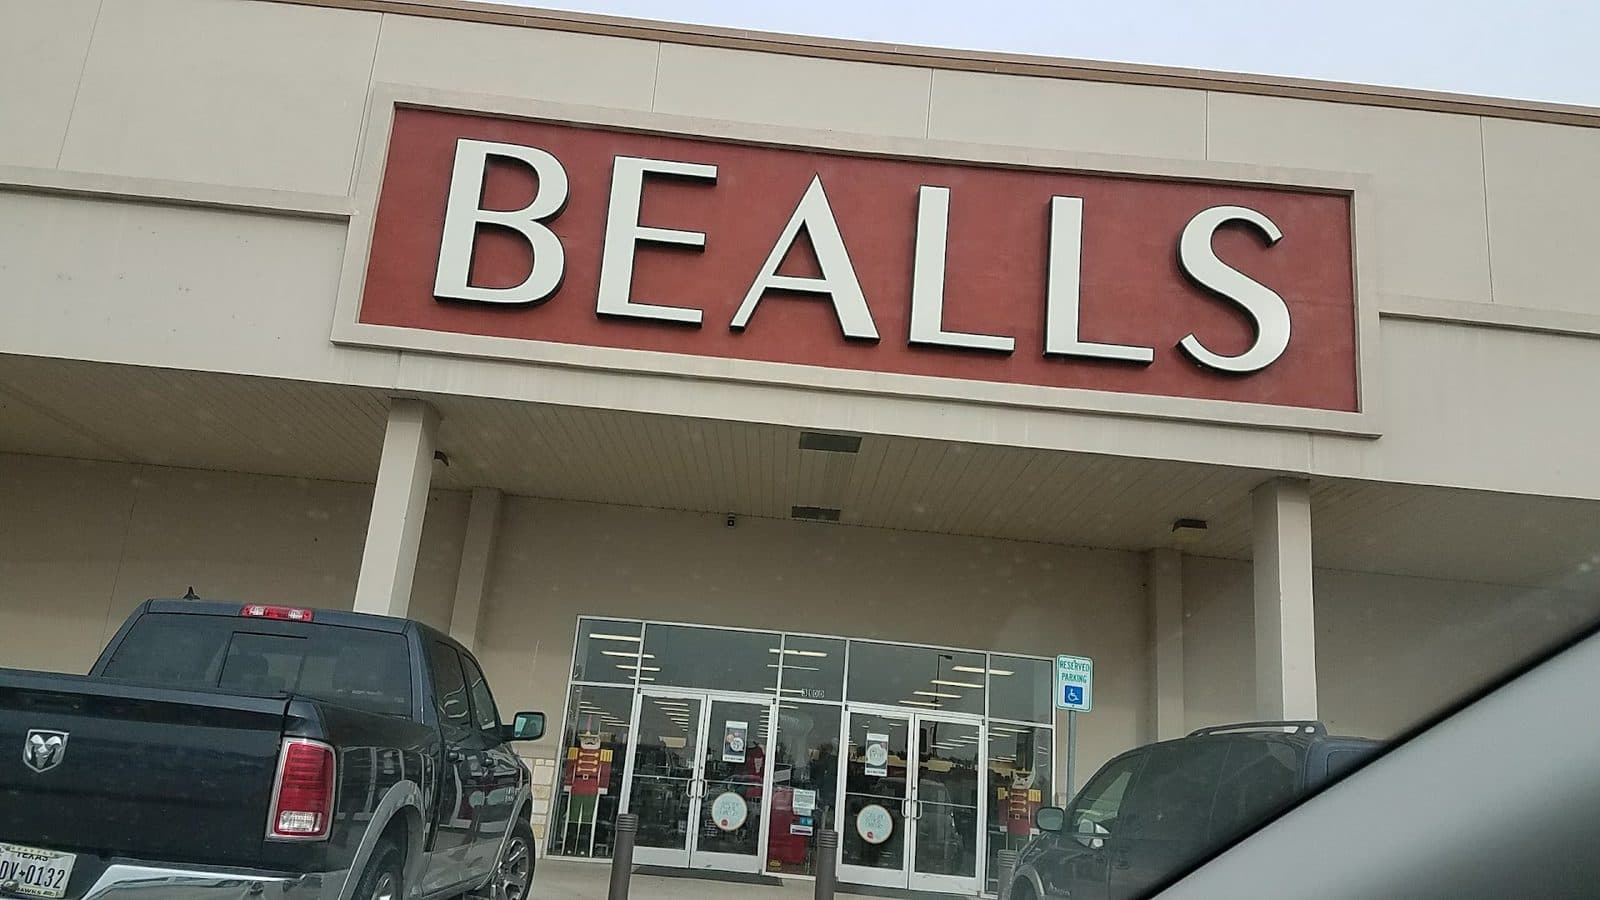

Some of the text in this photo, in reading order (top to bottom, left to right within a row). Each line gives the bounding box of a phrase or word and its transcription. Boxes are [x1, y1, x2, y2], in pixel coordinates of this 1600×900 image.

[433, 137, 1293, 374] BEALLS
[1059, 660, 1090, 671] RESERVED
[1061, 672, 1088, 683] PARKING
